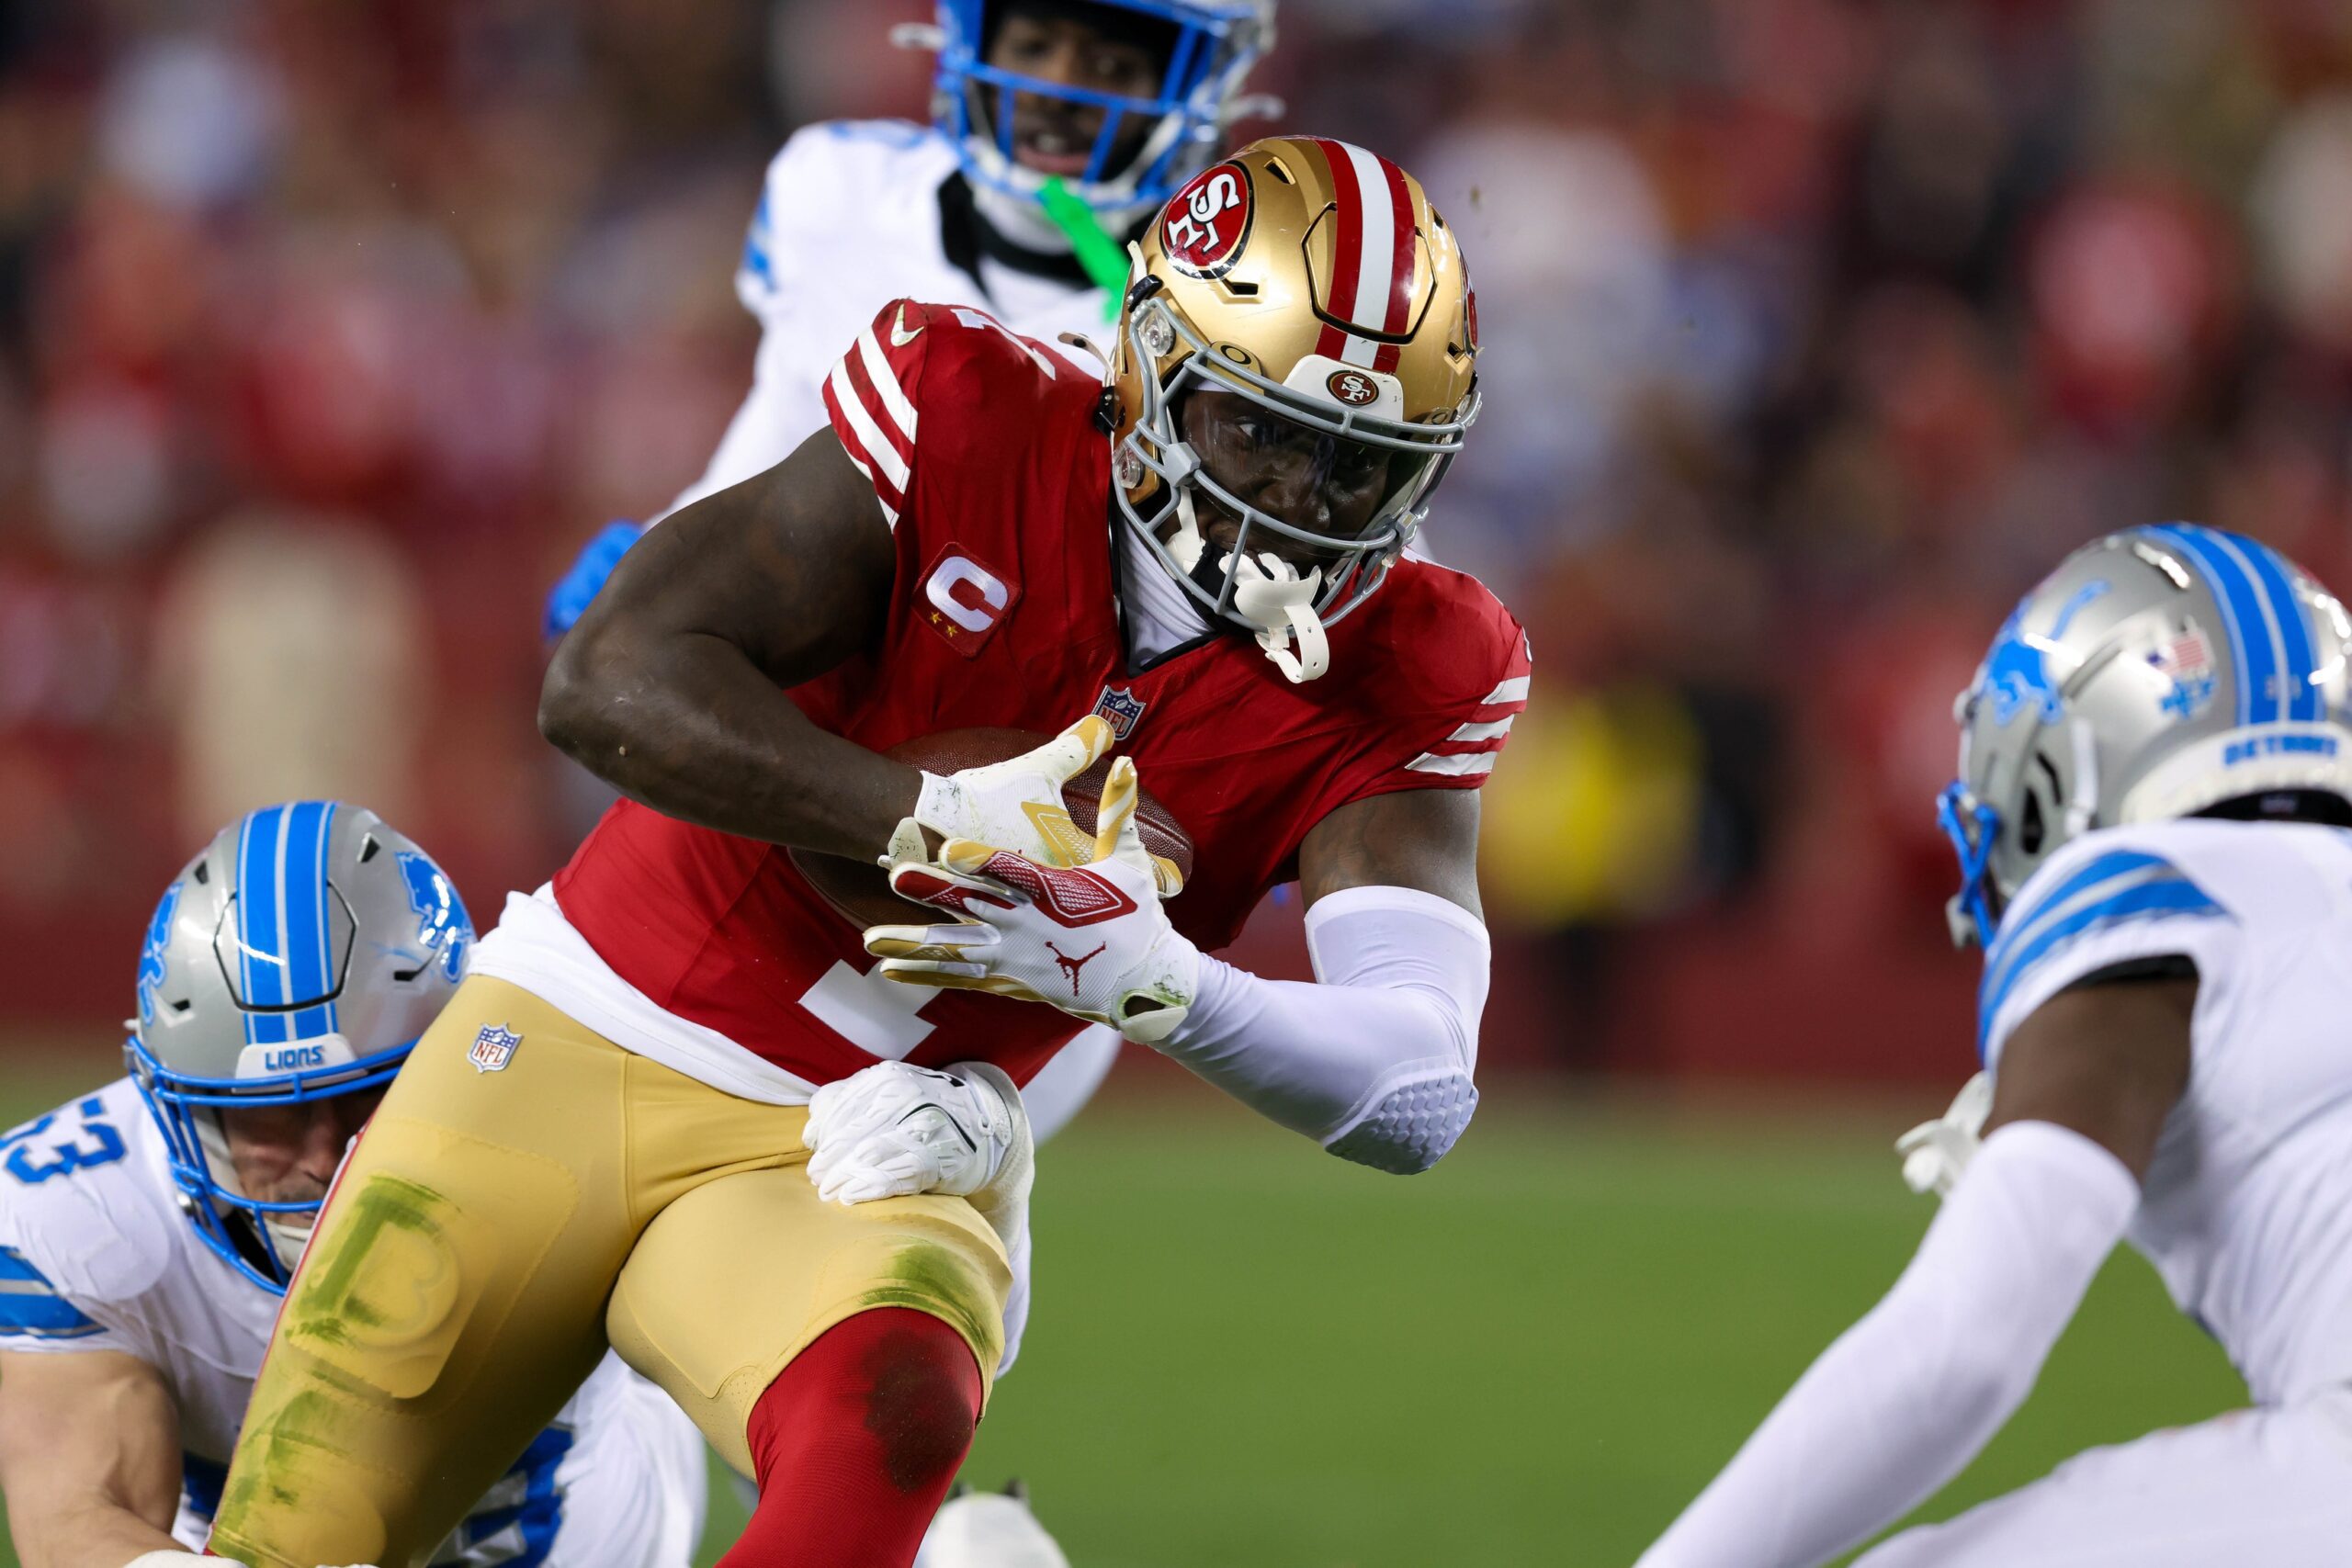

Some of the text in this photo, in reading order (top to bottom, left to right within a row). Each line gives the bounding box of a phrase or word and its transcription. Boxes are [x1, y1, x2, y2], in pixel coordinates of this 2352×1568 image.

[925, 556, 1009, 633] C
[1101, 706, 1129, 735] NFL
[265, 1044, 324, 1071] LIONS
[474, 1041, 504, 1065] NFL
